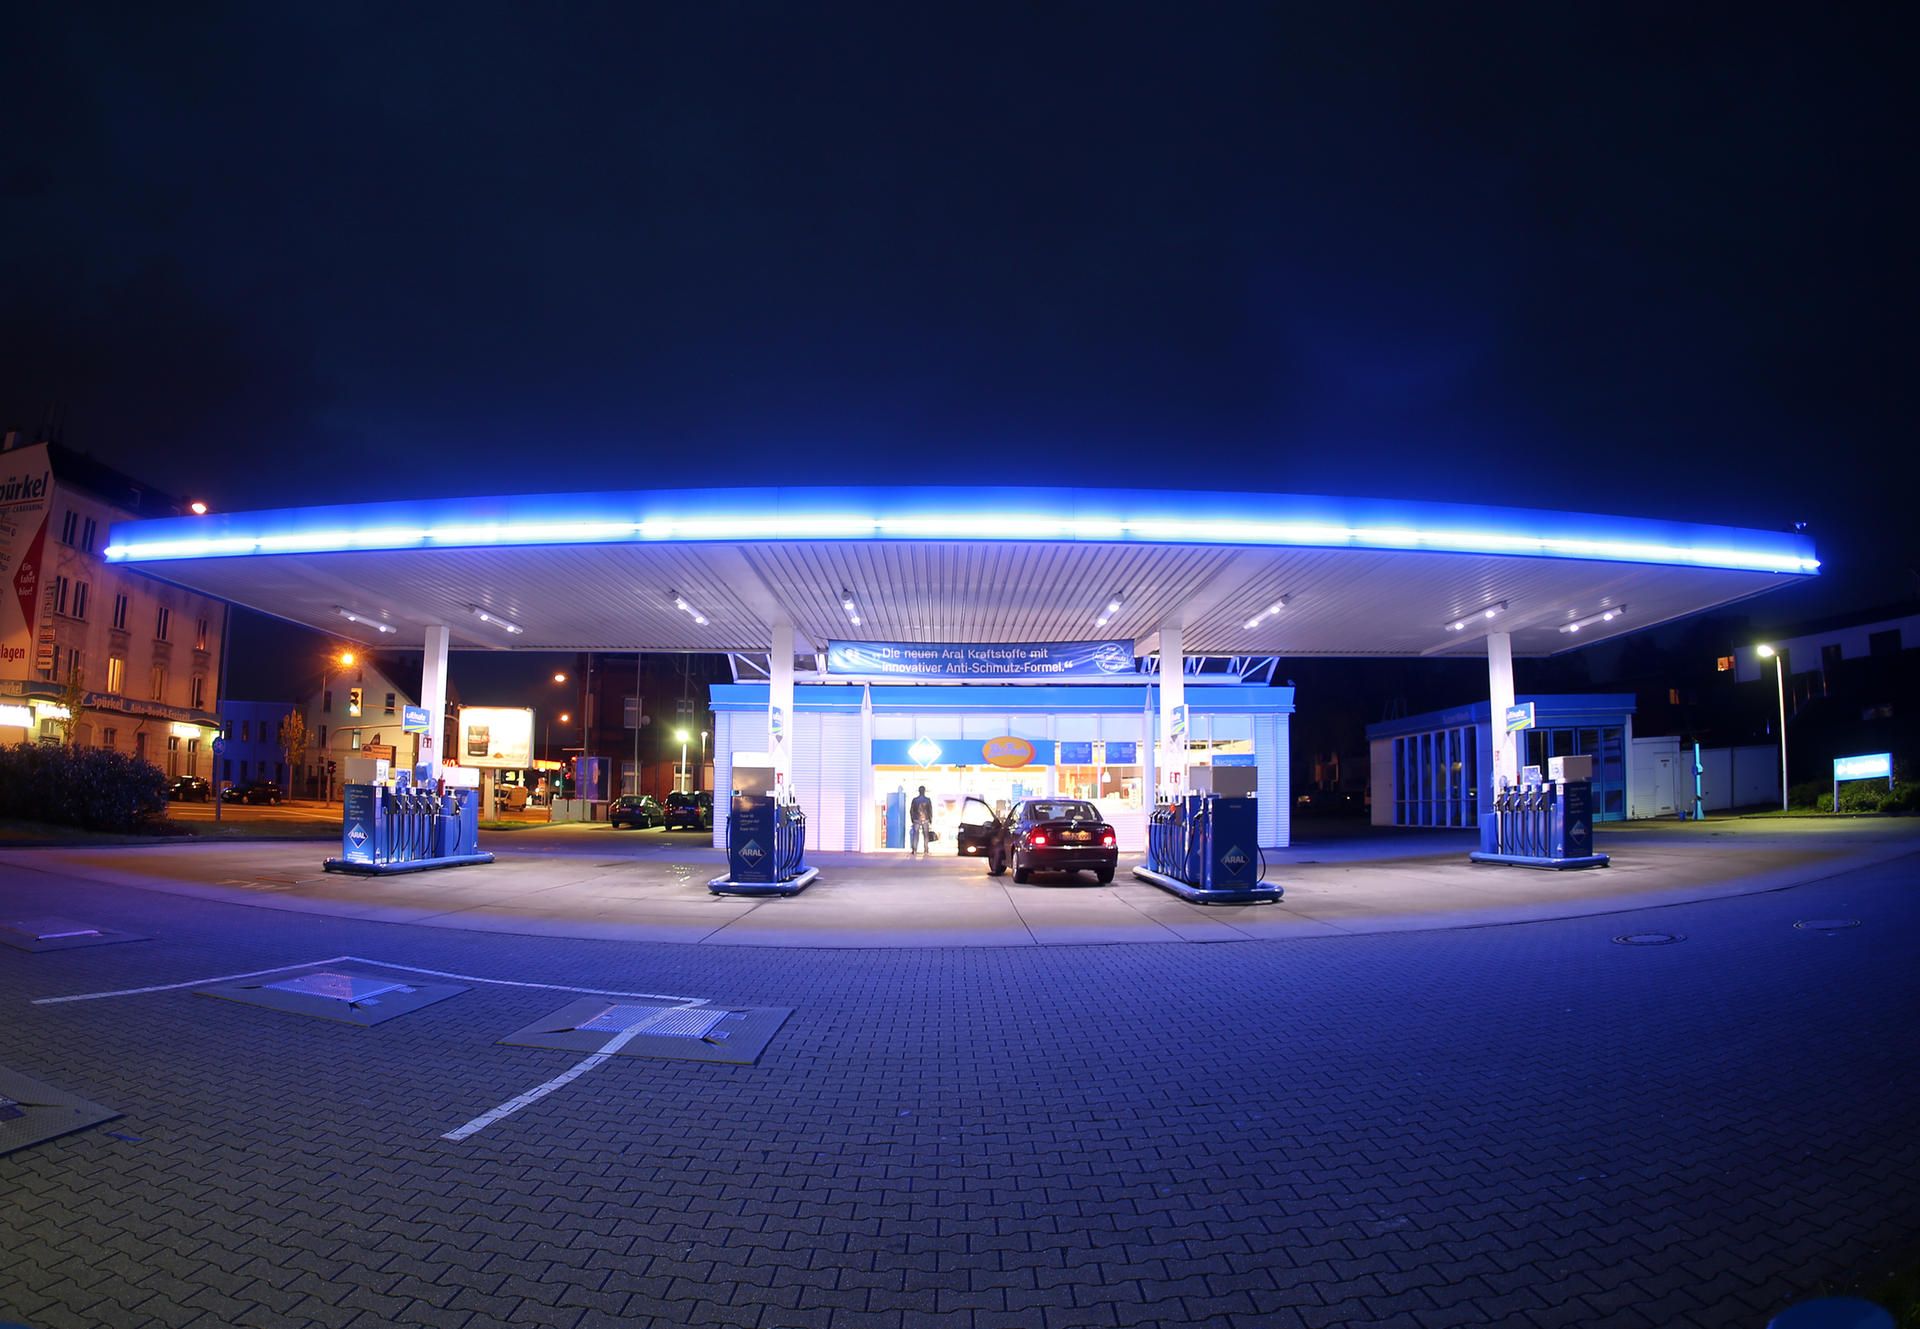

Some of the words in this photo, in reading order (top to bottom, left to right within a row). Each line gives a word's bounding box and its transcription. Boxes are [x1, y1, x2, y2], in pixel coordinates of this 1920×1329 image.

[904, 649, 938, 659] neuen
[942, 649, 963, 659] Aral
[968, 648, 1026, 659] Kraftstoffe
[1031, 648, 1048, 659] mit
[91, 694, 124, 711] Spürkel
[742, 849, 762, 857] ARAL
[1224, 855, 1245, 864] ARAL
